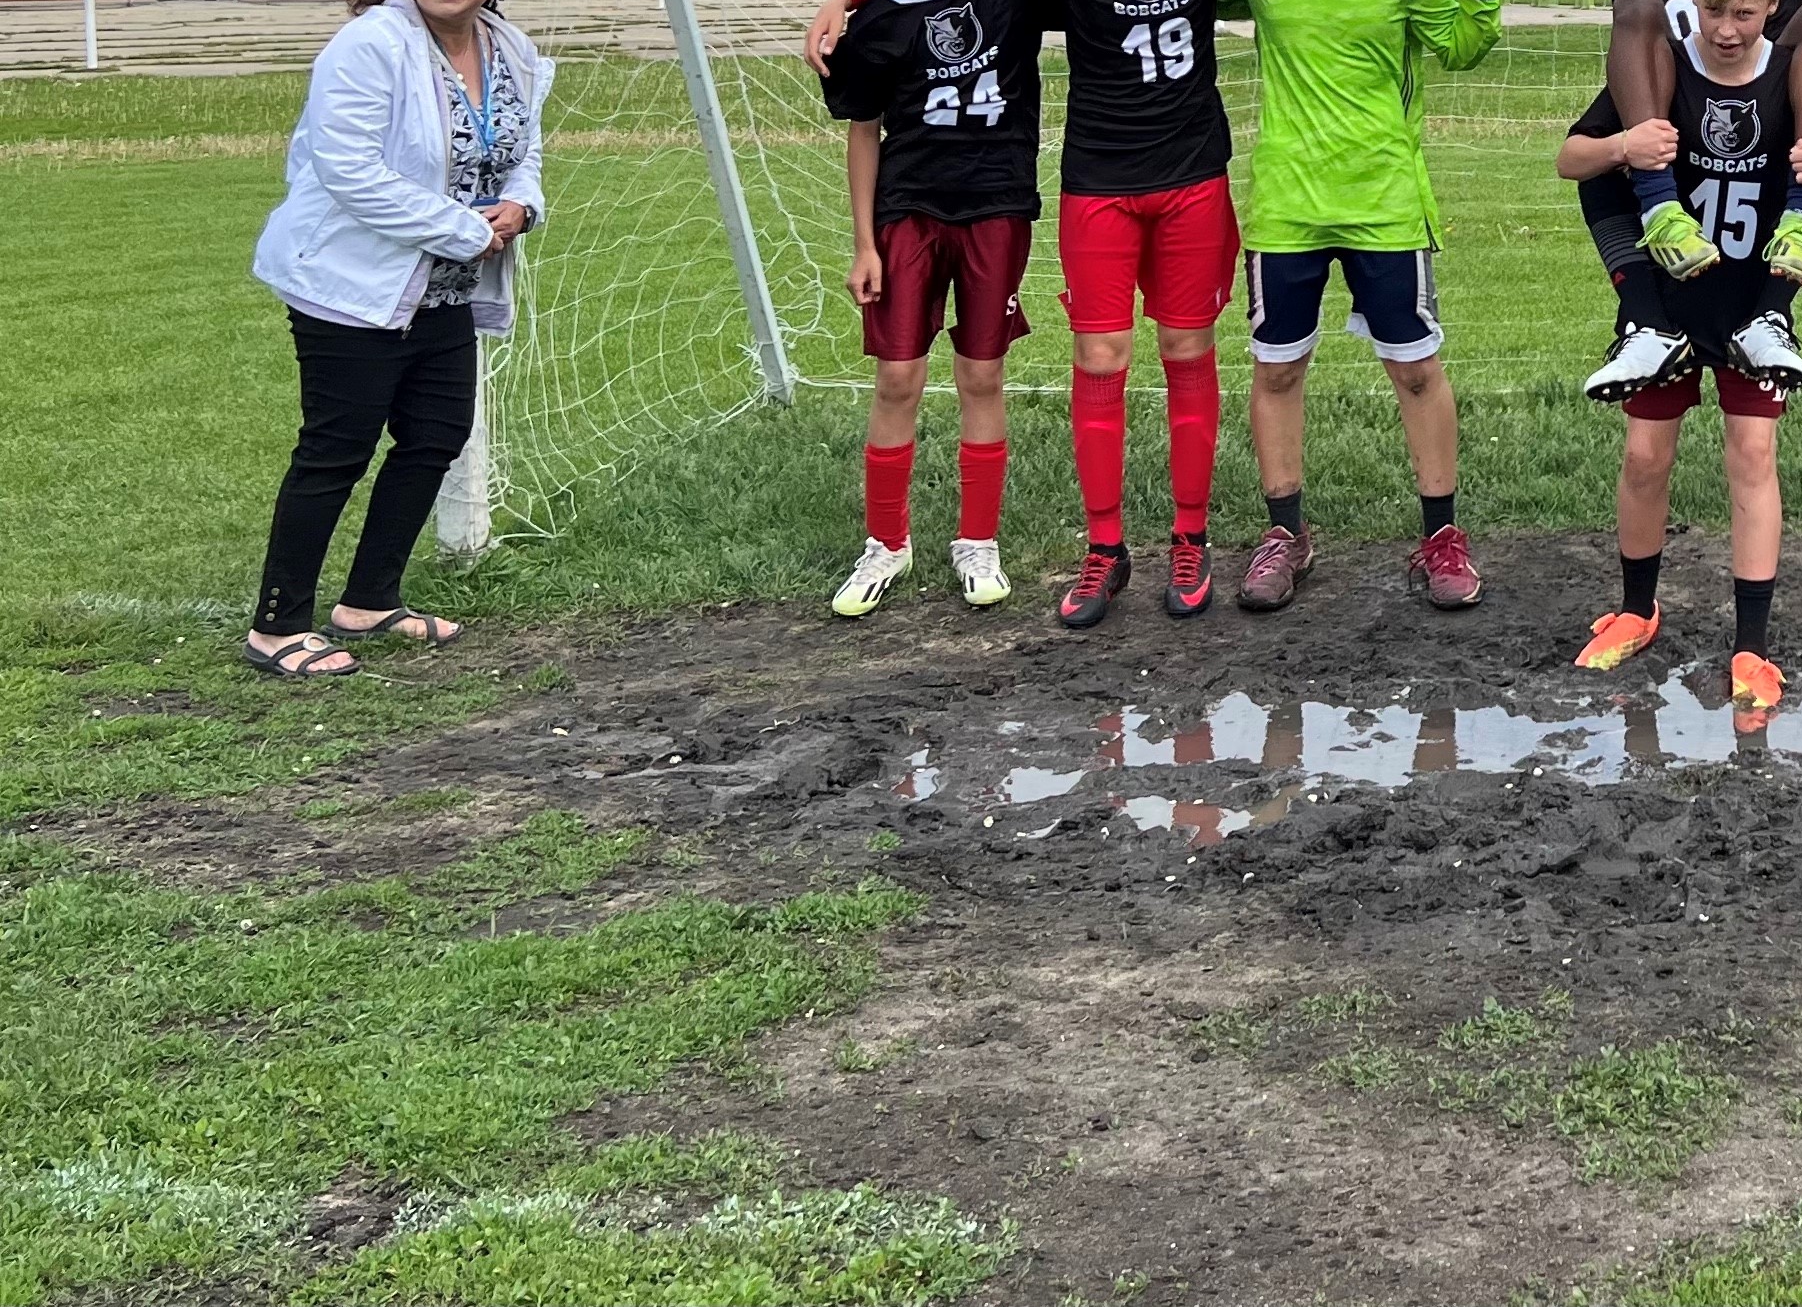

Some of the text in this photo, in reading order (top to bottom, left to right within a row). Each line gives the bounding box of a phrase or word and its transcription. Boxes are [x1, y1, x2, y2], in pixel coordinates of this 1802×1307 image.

[926, 45, 999, 80] BOBCATS
[1121, 17, 1194, 83] 19
[922, 69, 1007, 127] 24
[1689, 151, 1768, 173] BOBCATS
[1689, 178, 1761, 259] 15
